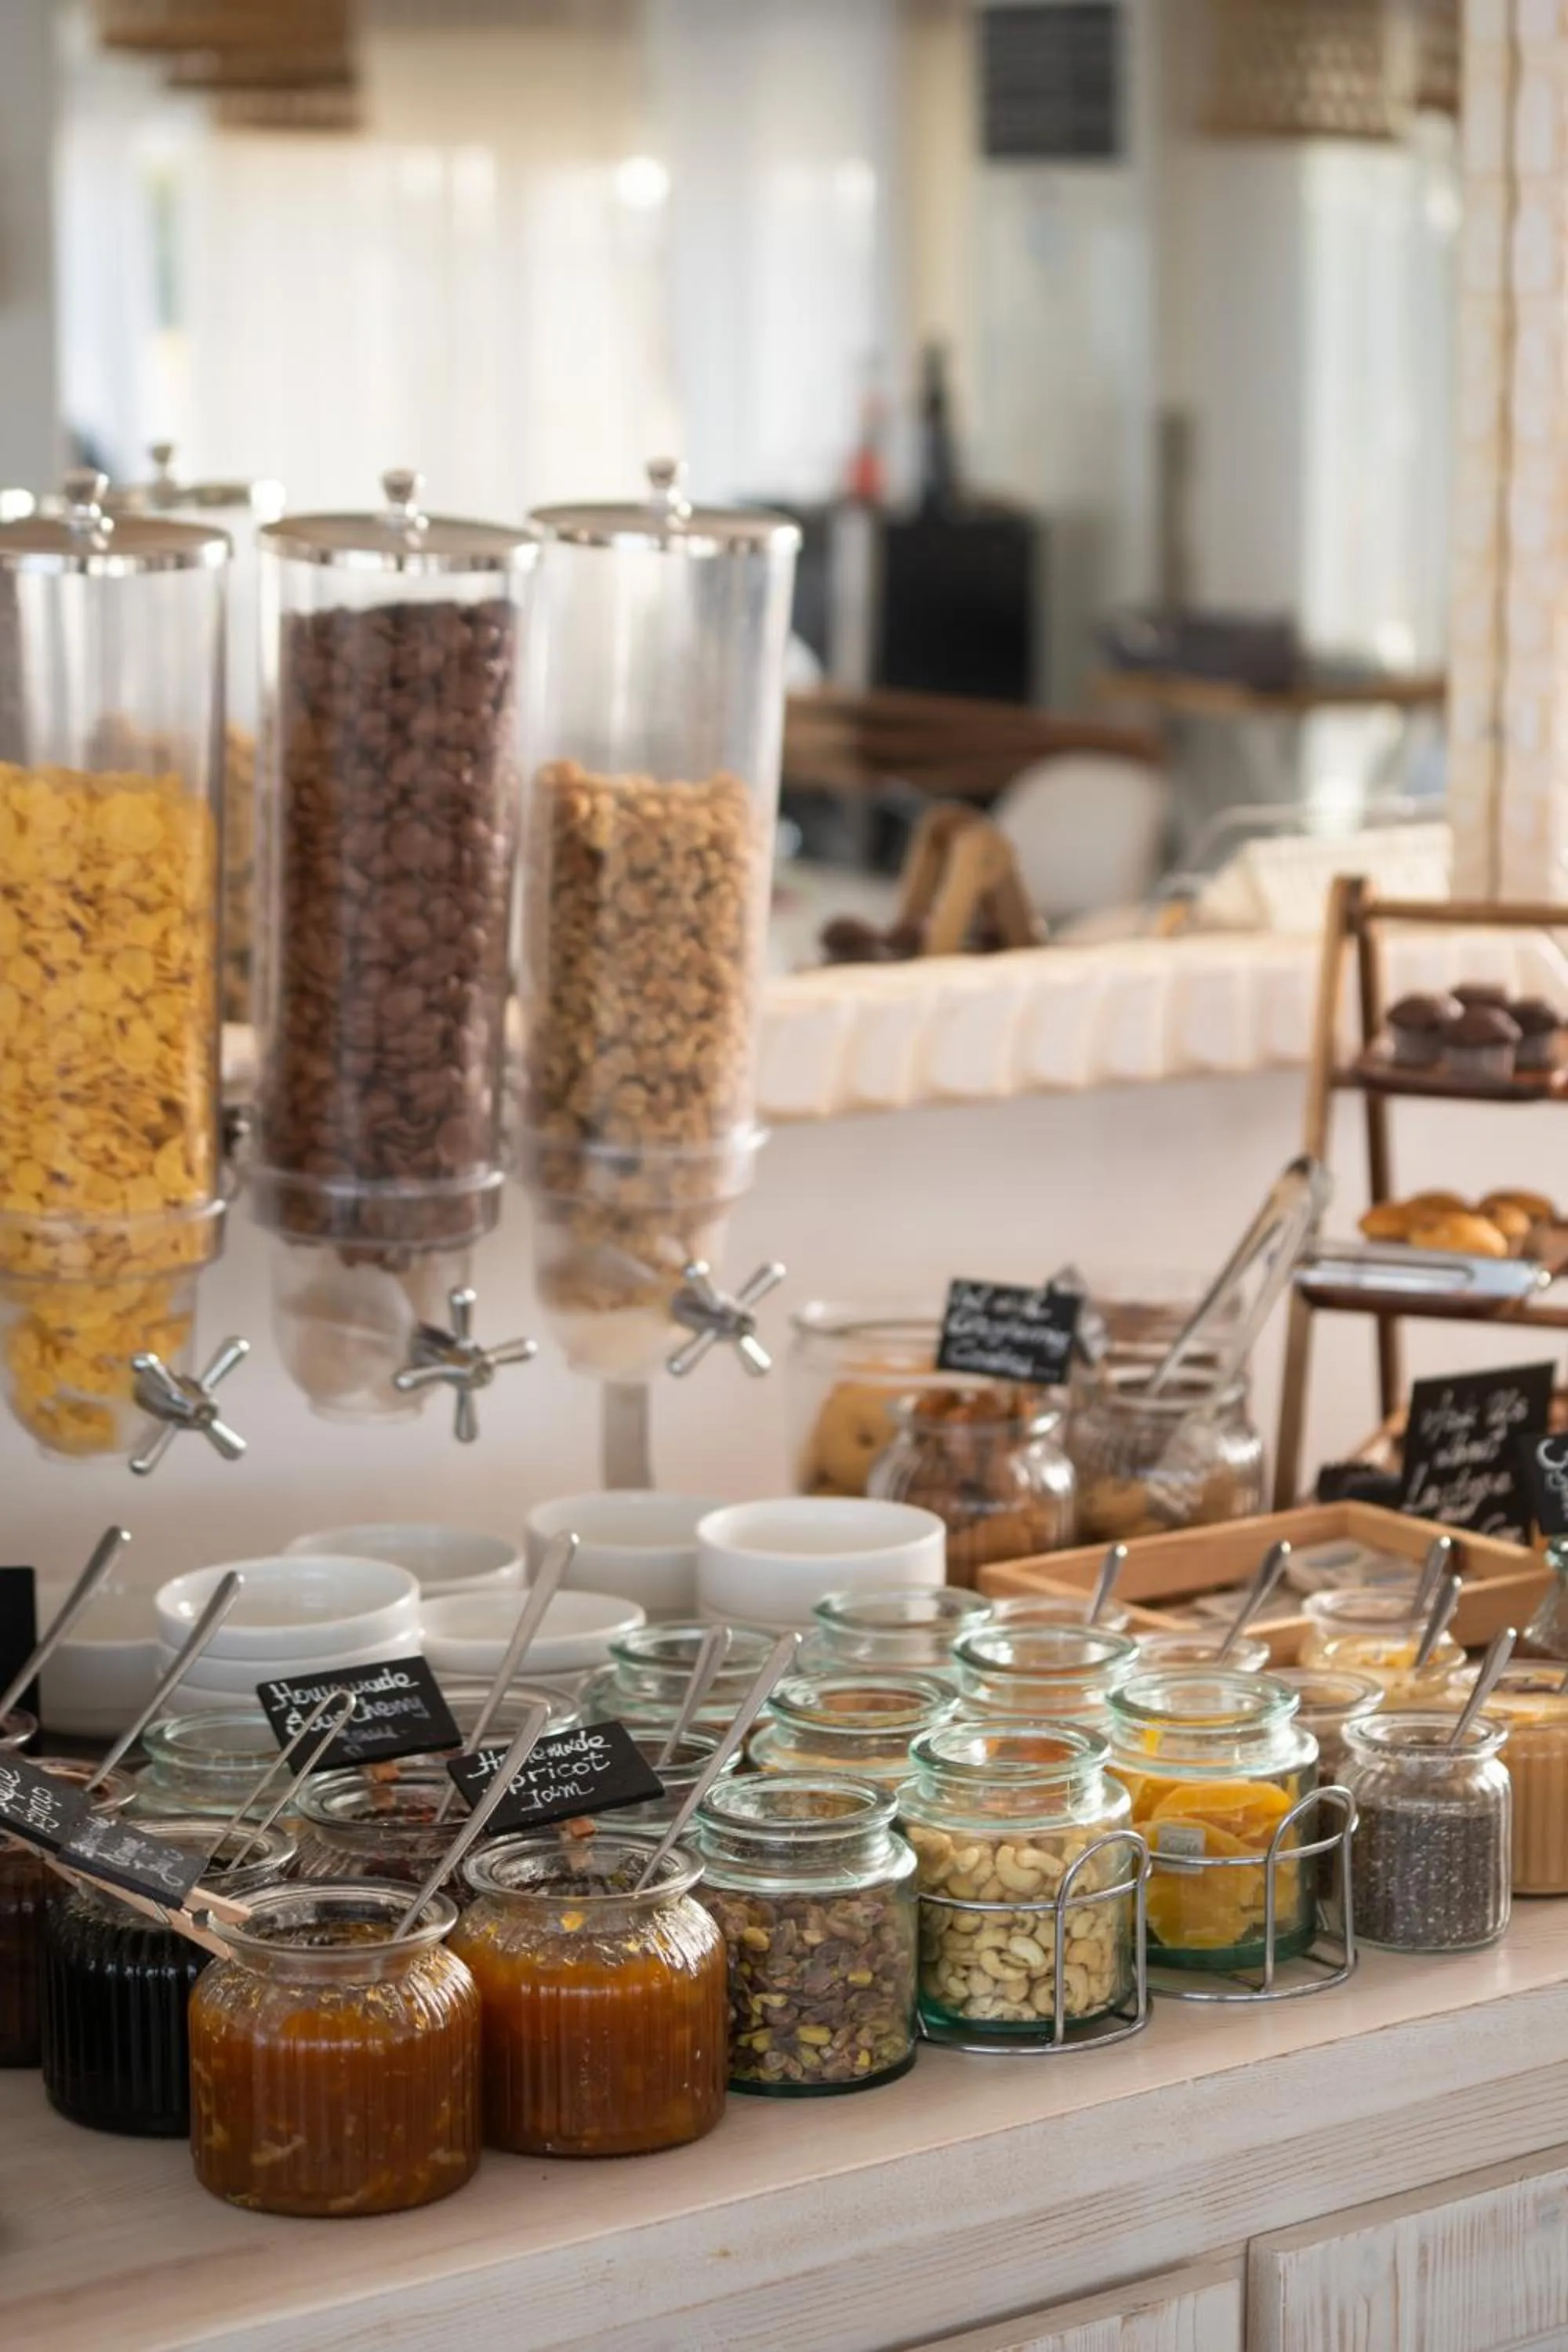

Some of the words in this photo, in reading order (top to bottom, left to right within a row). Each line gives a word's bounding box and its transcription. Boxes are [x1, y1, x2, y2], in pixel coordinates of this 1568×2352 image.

[466, 1730, 612, 1779] Hemade
[481, 1751, 611, 1795] pricot
[521, 1780, 596, 1812] Jam
